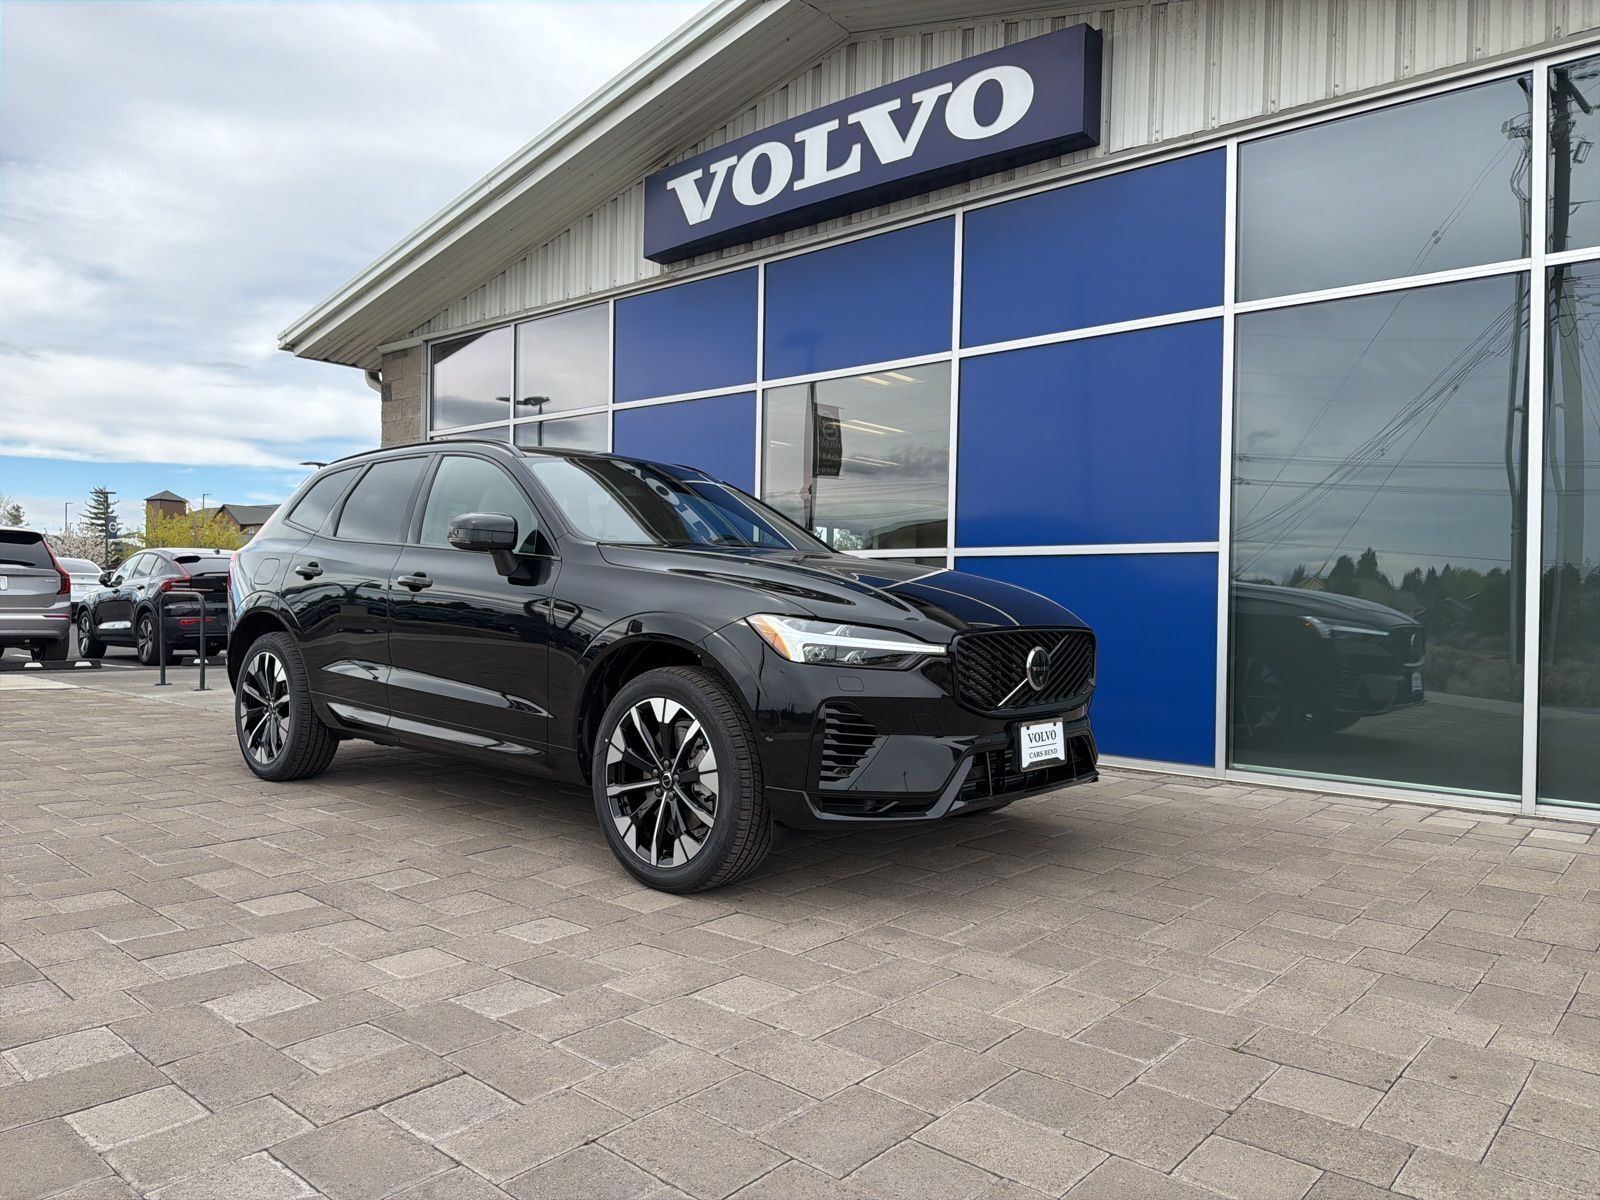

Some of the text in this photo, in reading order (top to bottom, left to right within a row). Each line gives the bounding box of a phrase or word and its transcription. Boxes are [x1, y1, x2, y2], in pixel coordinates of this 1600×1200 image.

[667, 65, 1034, 226] VOLVO
[1027, 730, 1057, 743] VOLVO
[1029, 748, 1058, 759] CARS BEND
